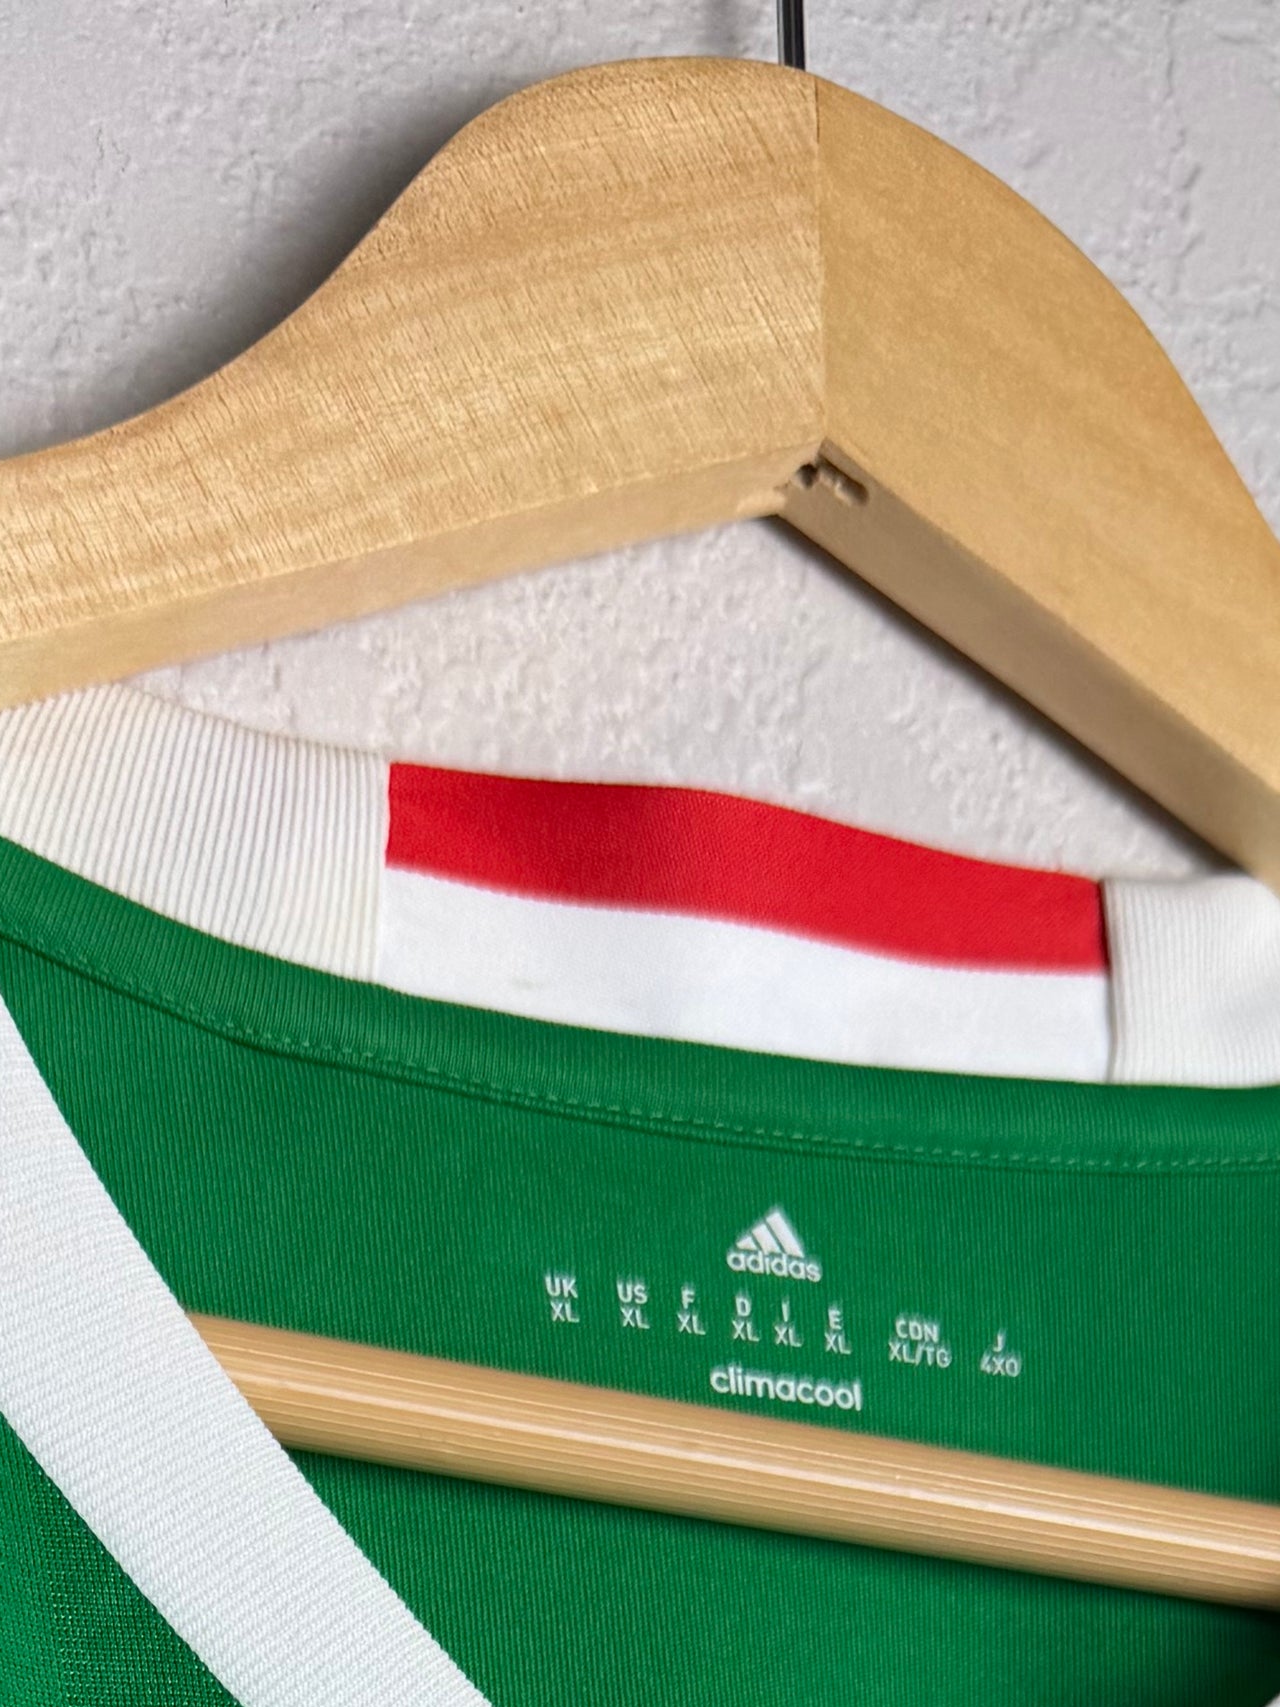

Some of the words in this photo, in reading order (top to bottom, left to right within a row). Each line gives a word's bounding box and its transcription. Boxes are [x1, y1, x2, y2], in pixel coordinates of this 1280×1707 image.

[727, 1250, 822, 1282] adidas
[545, 1274, 578, 1298] UK
[617, 1280, 648, 1304] US
[681, 1287, 695, 1309] F
[736, 1296, 751, 1317] D
[782, 1299, 790, 1322] I
[828, 1308, 843, 1330] E
[895, 1318, 939, 1342] CDN
[993, 1331, 1005, 1352] J
[550, 1300, 580, 1322] XL
[621, 1306, 650, 1329] XL
[677, 1312, 706, 1335] XL
[732, 1319, 760, 1342] XL
[775, 1325, 802, 1347] XL
[825, 1332, 851, 1354] XL
[889, 1340, 952, 1368] XL/TG
[980, 1351, 1021, 1377] 4XO
[710, 1366, 862, 1411] climacool
